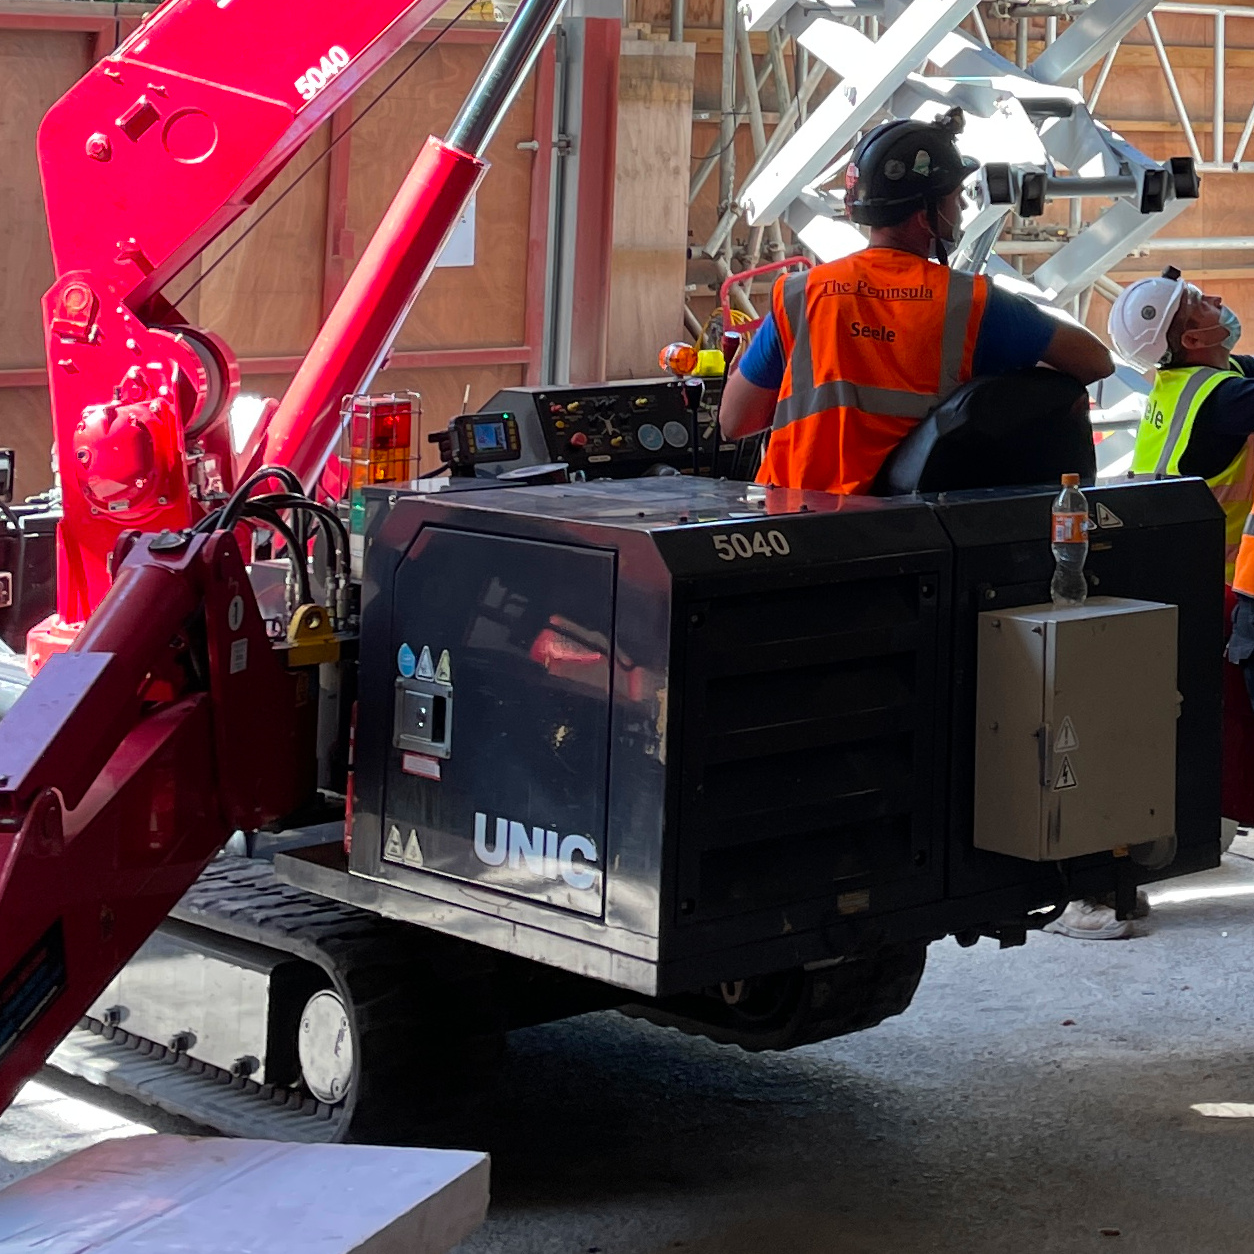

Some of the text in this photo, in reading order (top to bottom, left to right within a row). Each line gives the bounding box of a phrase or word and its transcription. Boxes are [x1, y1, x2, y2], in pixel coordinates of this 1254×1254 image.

[294, 46, 350, 100] 5040
[823, 280, 933, 299] The Peninsula
[851, 322, 896, 342] Seele
[1144, 400, 1164, 429] ele
[713, 530, 791, 561] 5040
[474, 811, 598, 890] UNIC
